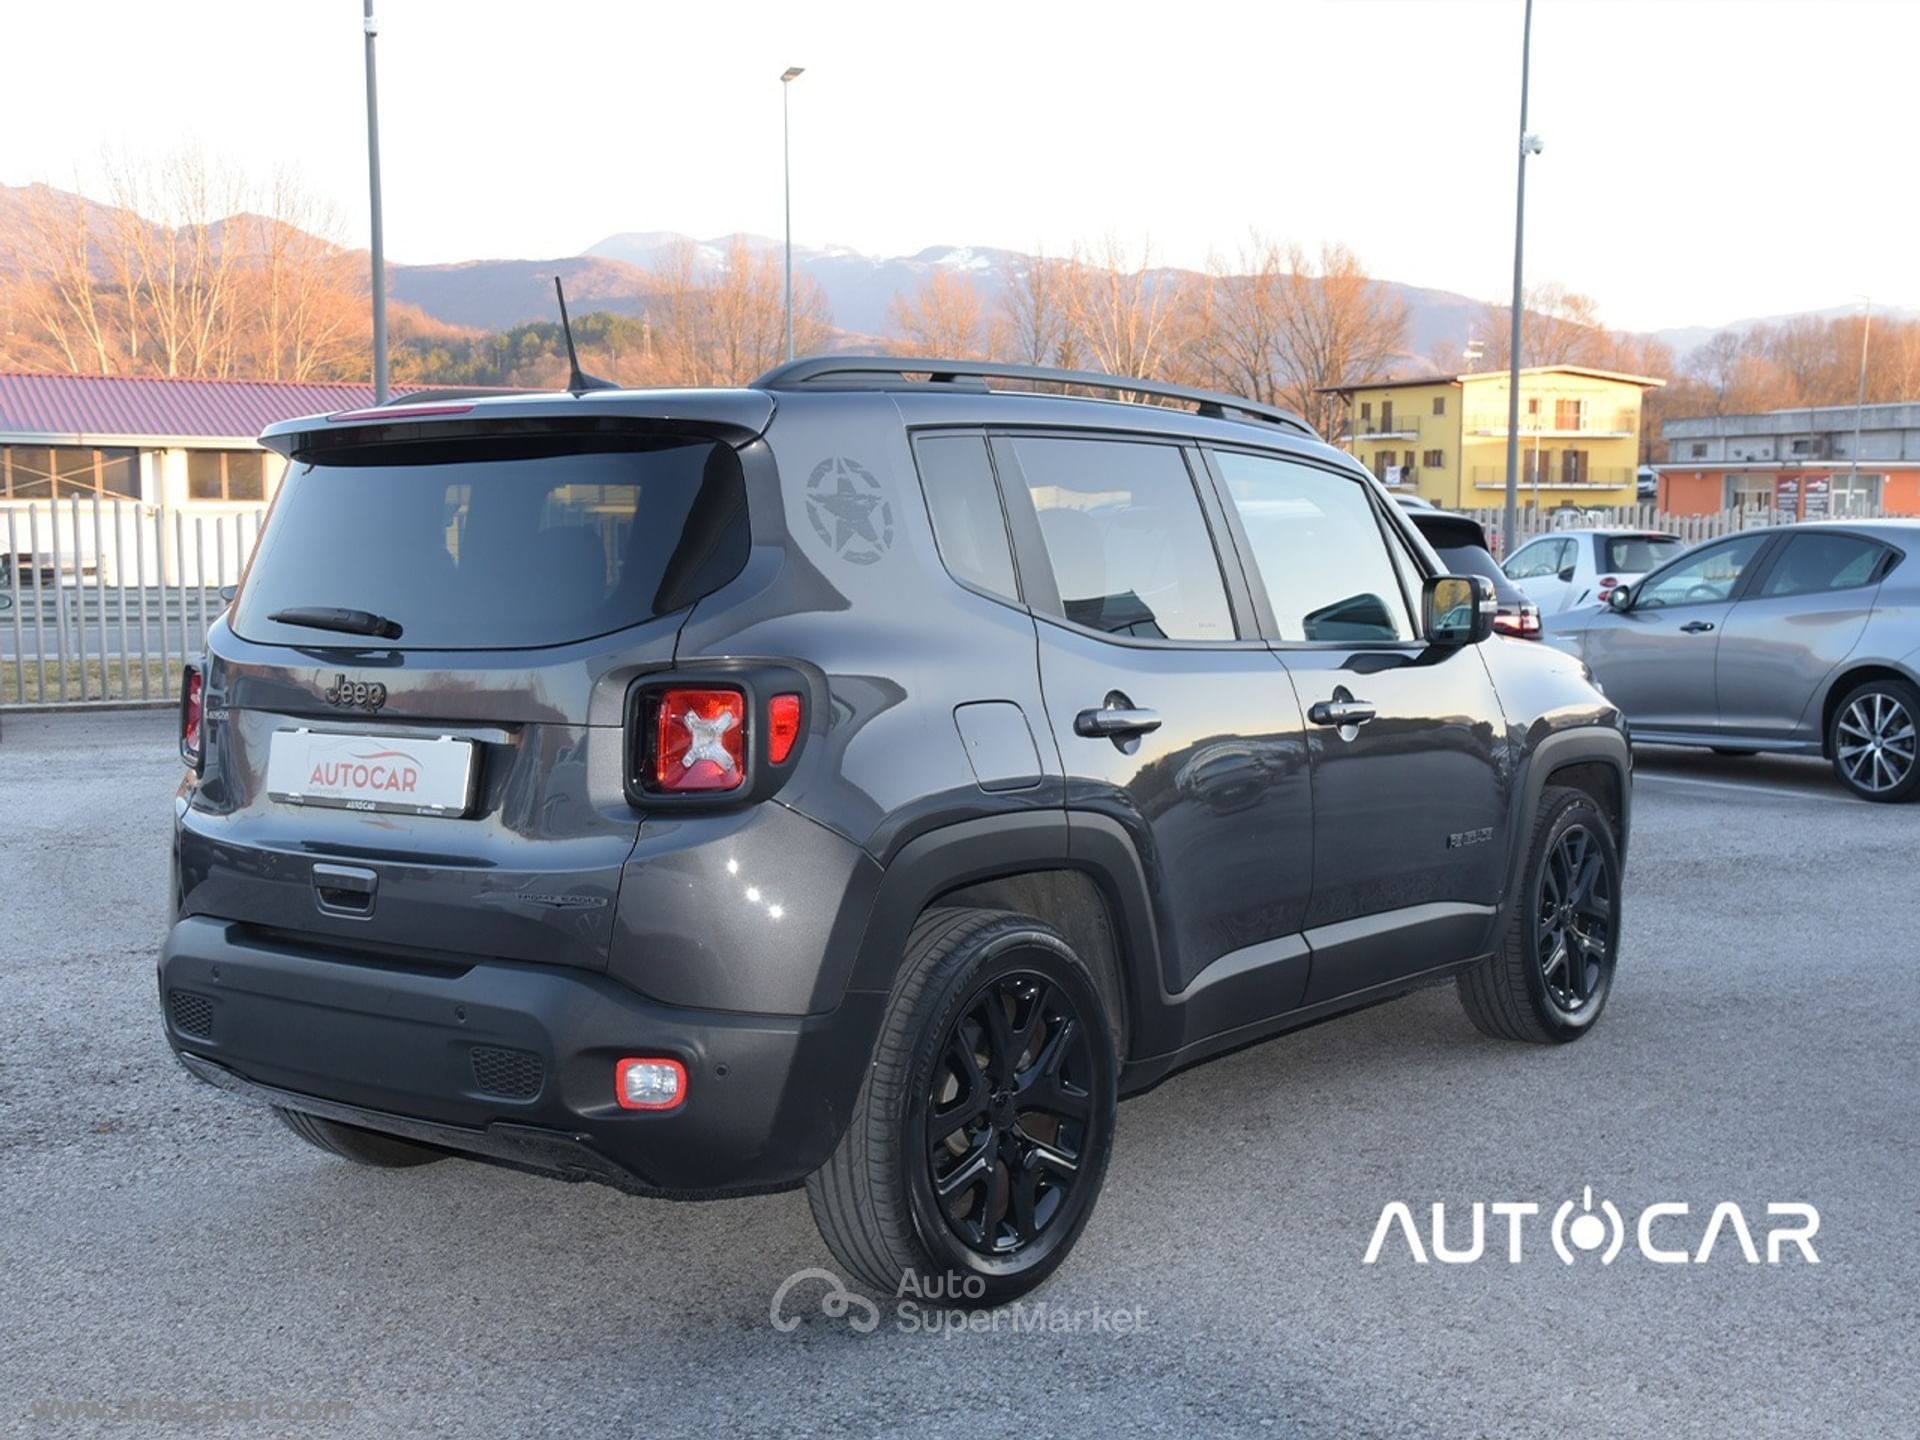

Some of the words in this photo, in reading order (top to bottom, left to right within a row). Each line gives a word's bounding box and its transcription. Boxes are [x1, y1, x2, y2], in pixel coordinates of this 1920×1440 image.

[325, 674, 387, 714] Jeep
[309, 762, 418, 793] AUTOCAR
[346, 801, 377, 811] AUTOCAR
